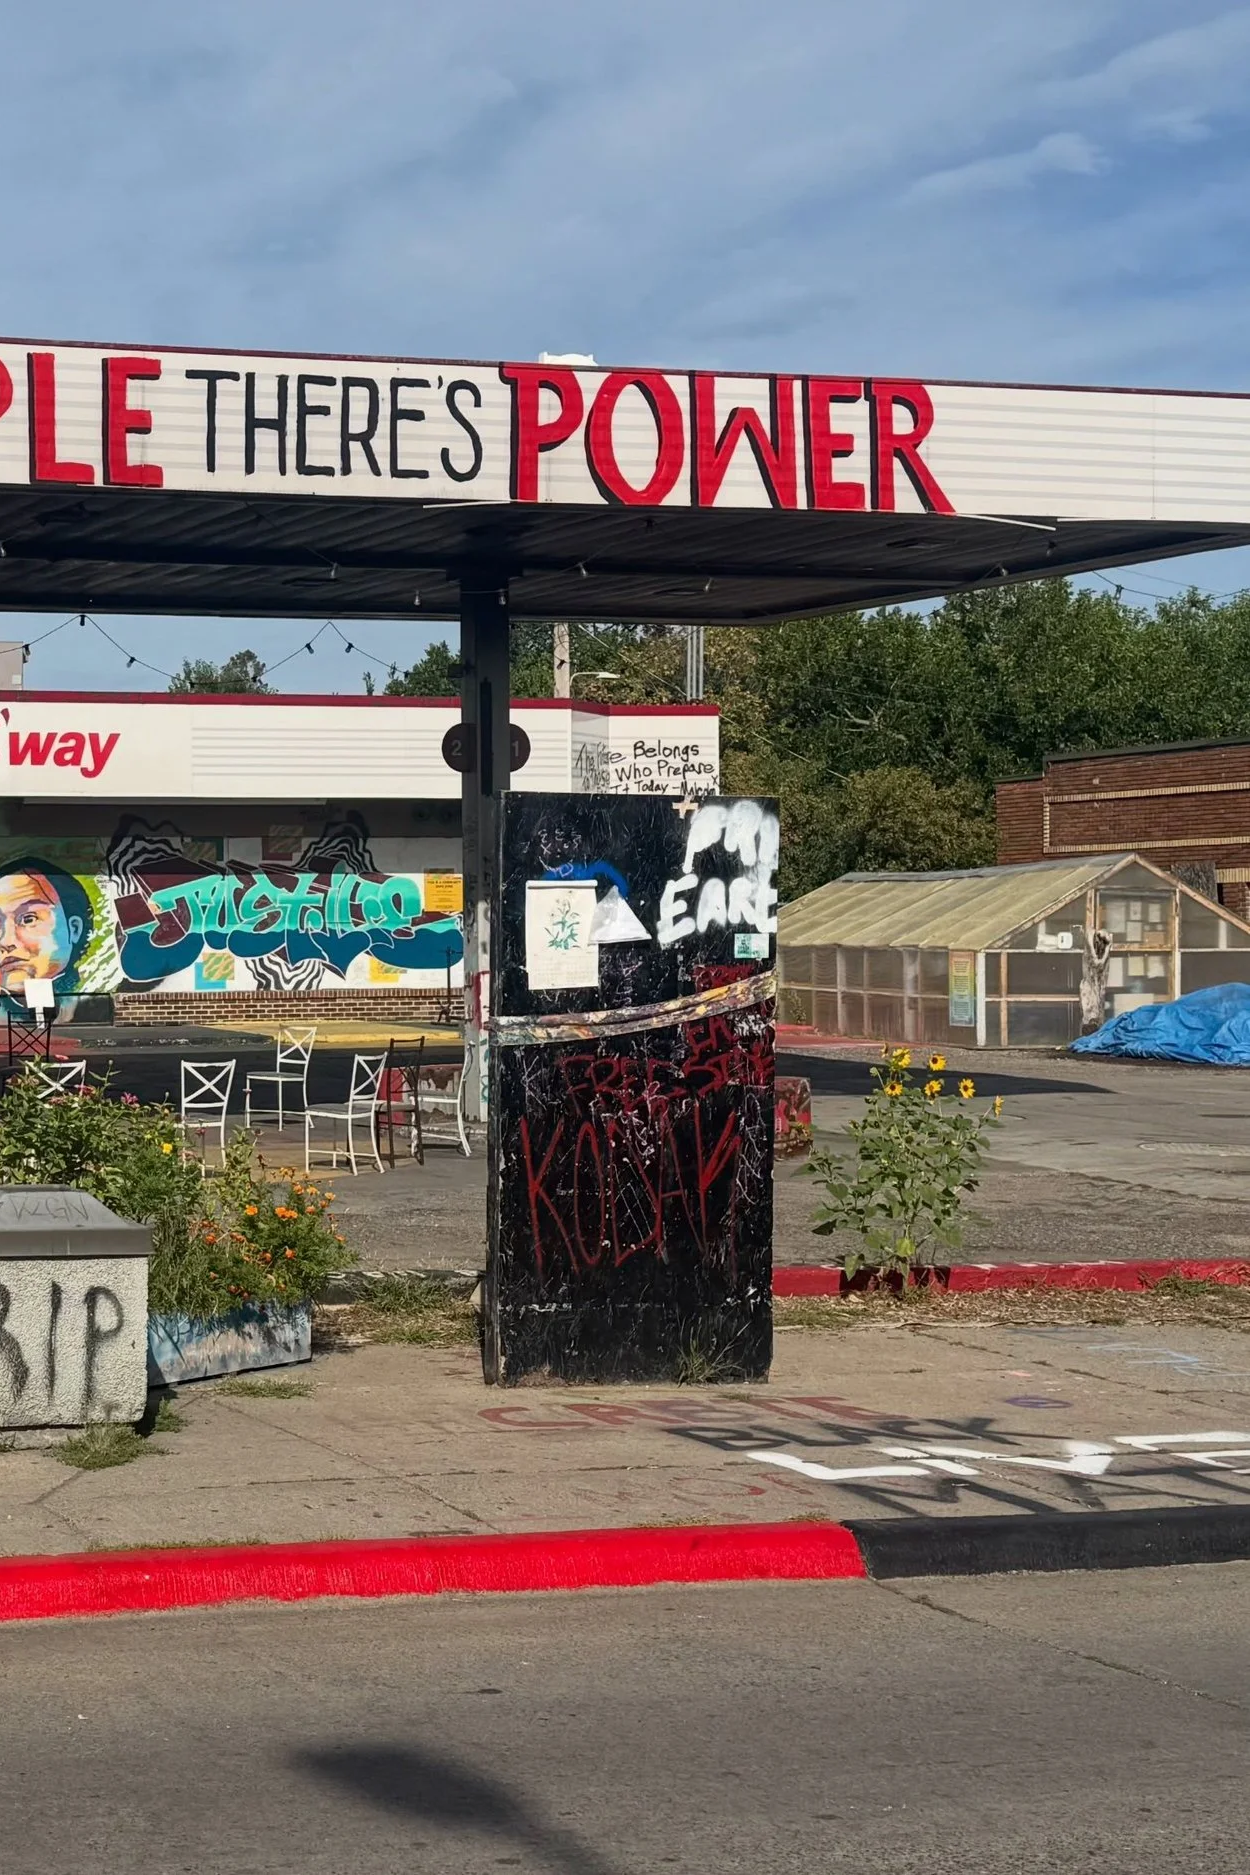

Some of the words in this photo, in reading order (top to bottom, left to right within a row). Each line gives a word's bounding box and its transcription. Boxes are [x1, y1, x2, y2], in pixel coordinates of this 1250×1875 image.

[185, 369, 483, 483] THERE'S
[499, 361, 957, 515] POWER
[451, 739, 462, 756] 2
[511, 740, 519, 757] 1
[633, 739, 700, 762] Belongs
[615, 762, 653, 782] Who
[657, 760, 715, 779] Prepare
[635, 780, 669, 793] Today
[661, 1417, 1073, 1451] BLACK
